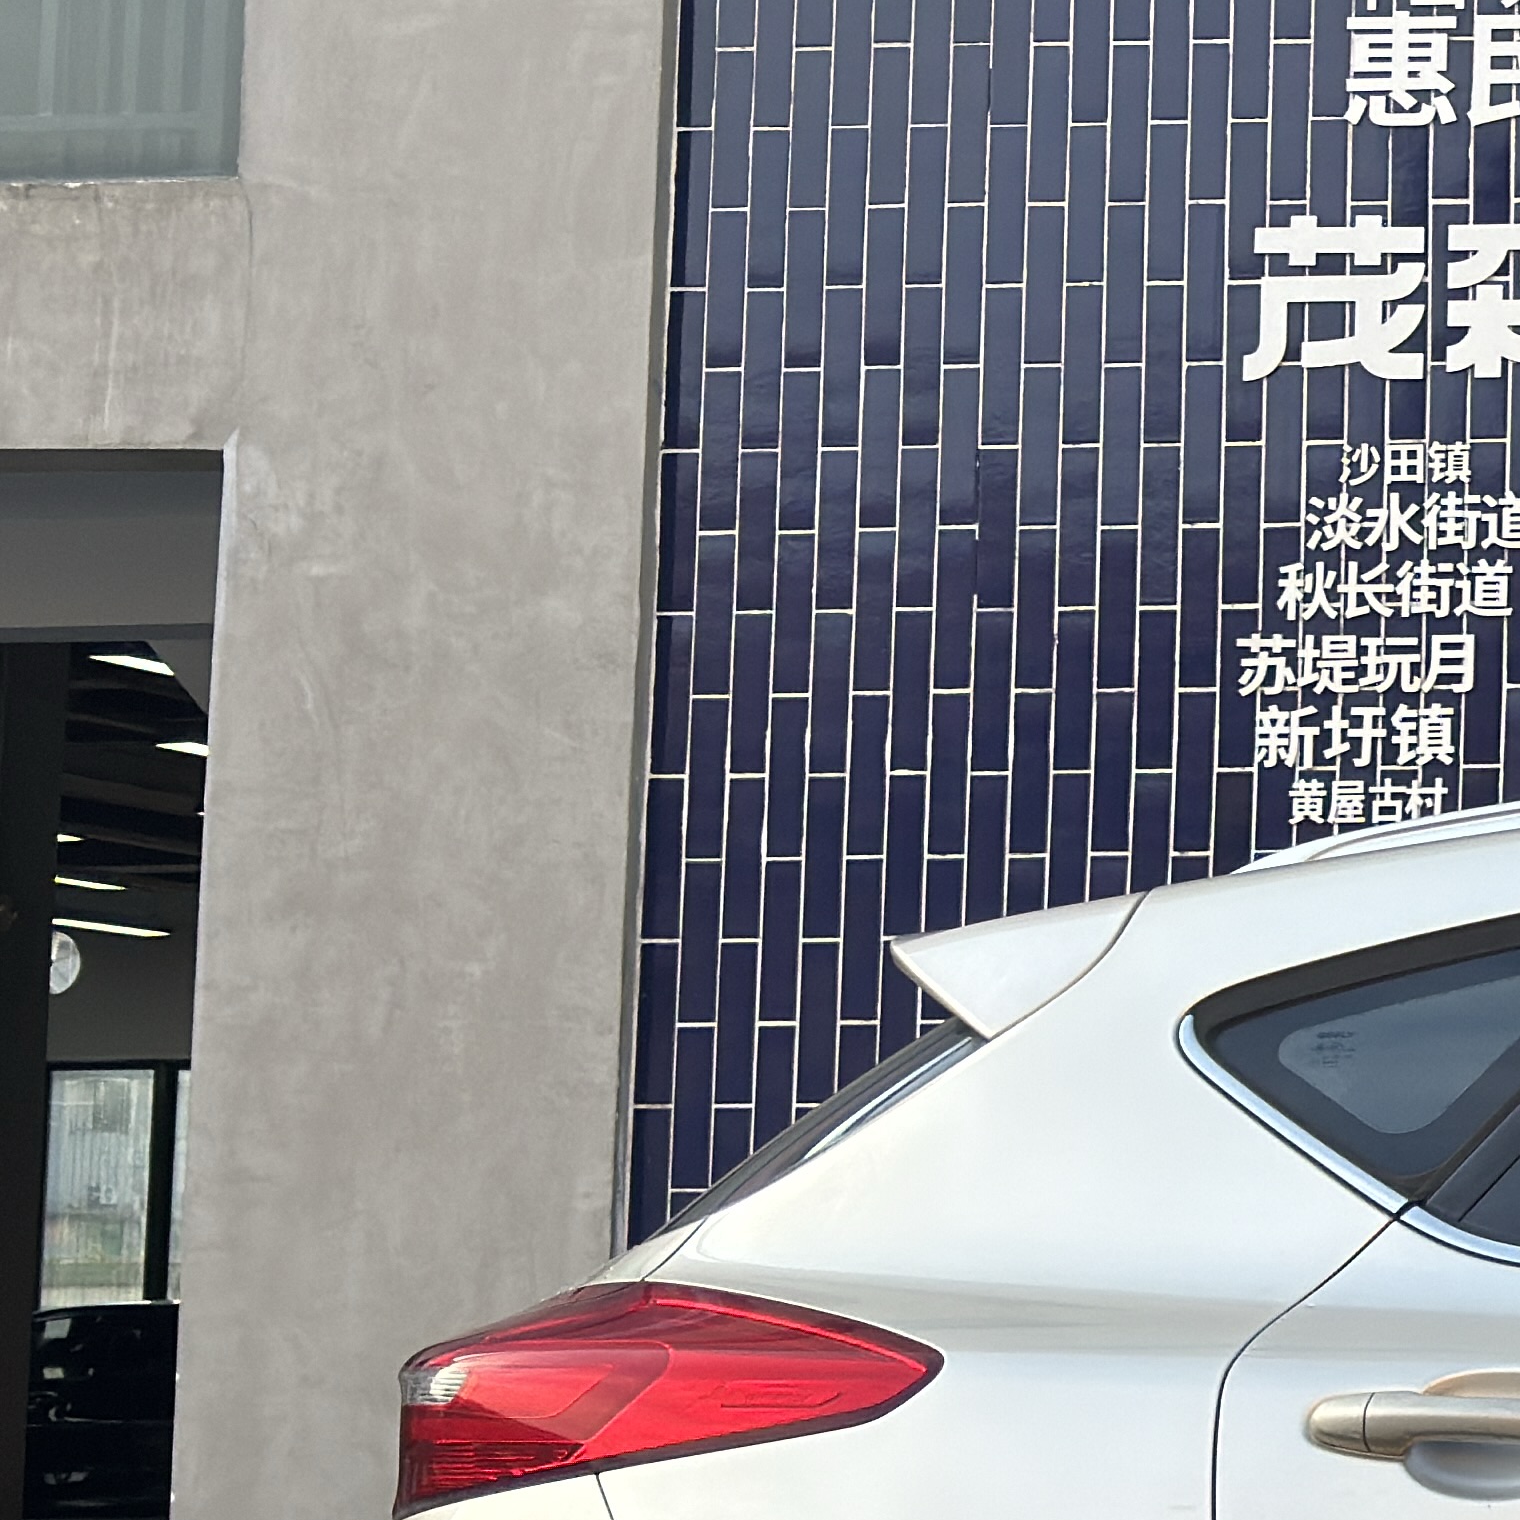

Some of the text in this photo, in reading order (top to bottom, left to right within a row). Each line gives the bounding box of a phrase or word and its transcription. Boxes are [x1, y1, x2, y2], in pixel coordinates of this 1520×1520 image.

[1339, 441, 1472, 485] 沙田镇
[1278, 560, 1513, 621] 秋长街道
[1236, 633, 1475, 697] 苏堤玩月
[1255, 704, 1456, 770] 新圩镇
[1289, 777, 1448, 825] 黄屋古村
